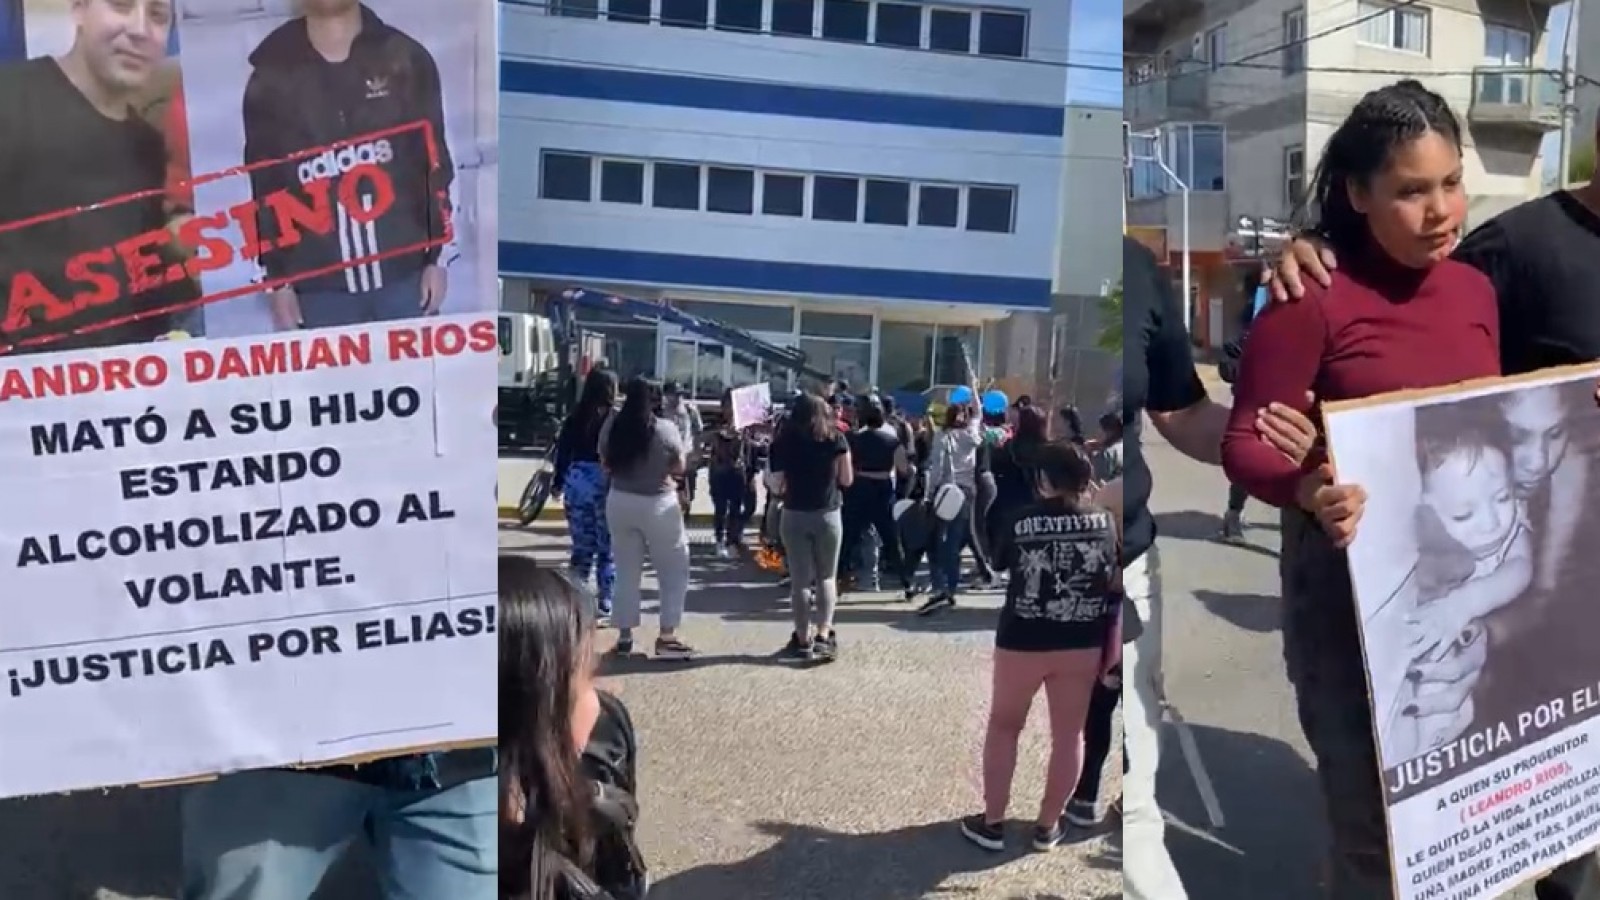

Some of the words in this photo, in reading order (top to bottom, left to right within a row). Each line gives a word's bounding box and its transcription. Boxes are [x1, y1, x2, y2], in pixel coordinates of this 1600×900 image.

[298, 139, 393, 184] adidas
[1, 163, 395, 334] ASESINO
[184, 333, 371, 384] DAMIAN
[388, 320, 497, 361] RIOS
[31, 407, 167, 456] MATÓ
[183, 409, 216, 441] A
[230, 400, 292, 435] SU
[310, 386, 421, 427] HIJO
[120, 447, 341, 500] ESTANDO
[16, 498, 381, 567] ALCOHOLIZADO
[396, 491, 455, 525] AL
[124, 556, 356, 609] VOLANTE.
[8, 639, 235, 697] ¡JUSTICIA
[248, 625, 341, 662] POR
[355, 606, 497, 651] ELIAS!
[1389, 720, 1512, 794] JUSTICIA
[1518, 697, 1566, 737] POR
[1436, 798, 1448, 811] A
[1449, 778, 1490, 804] QUIEN
[1493, 767, 1511, 784] SU
[1513, 733, 1589, 776] PROGENITOR
[1406, 849, 1425, 867] LE
[1473, 820, 1490, 835] LA
[1495, 832, 1504, 845] A
